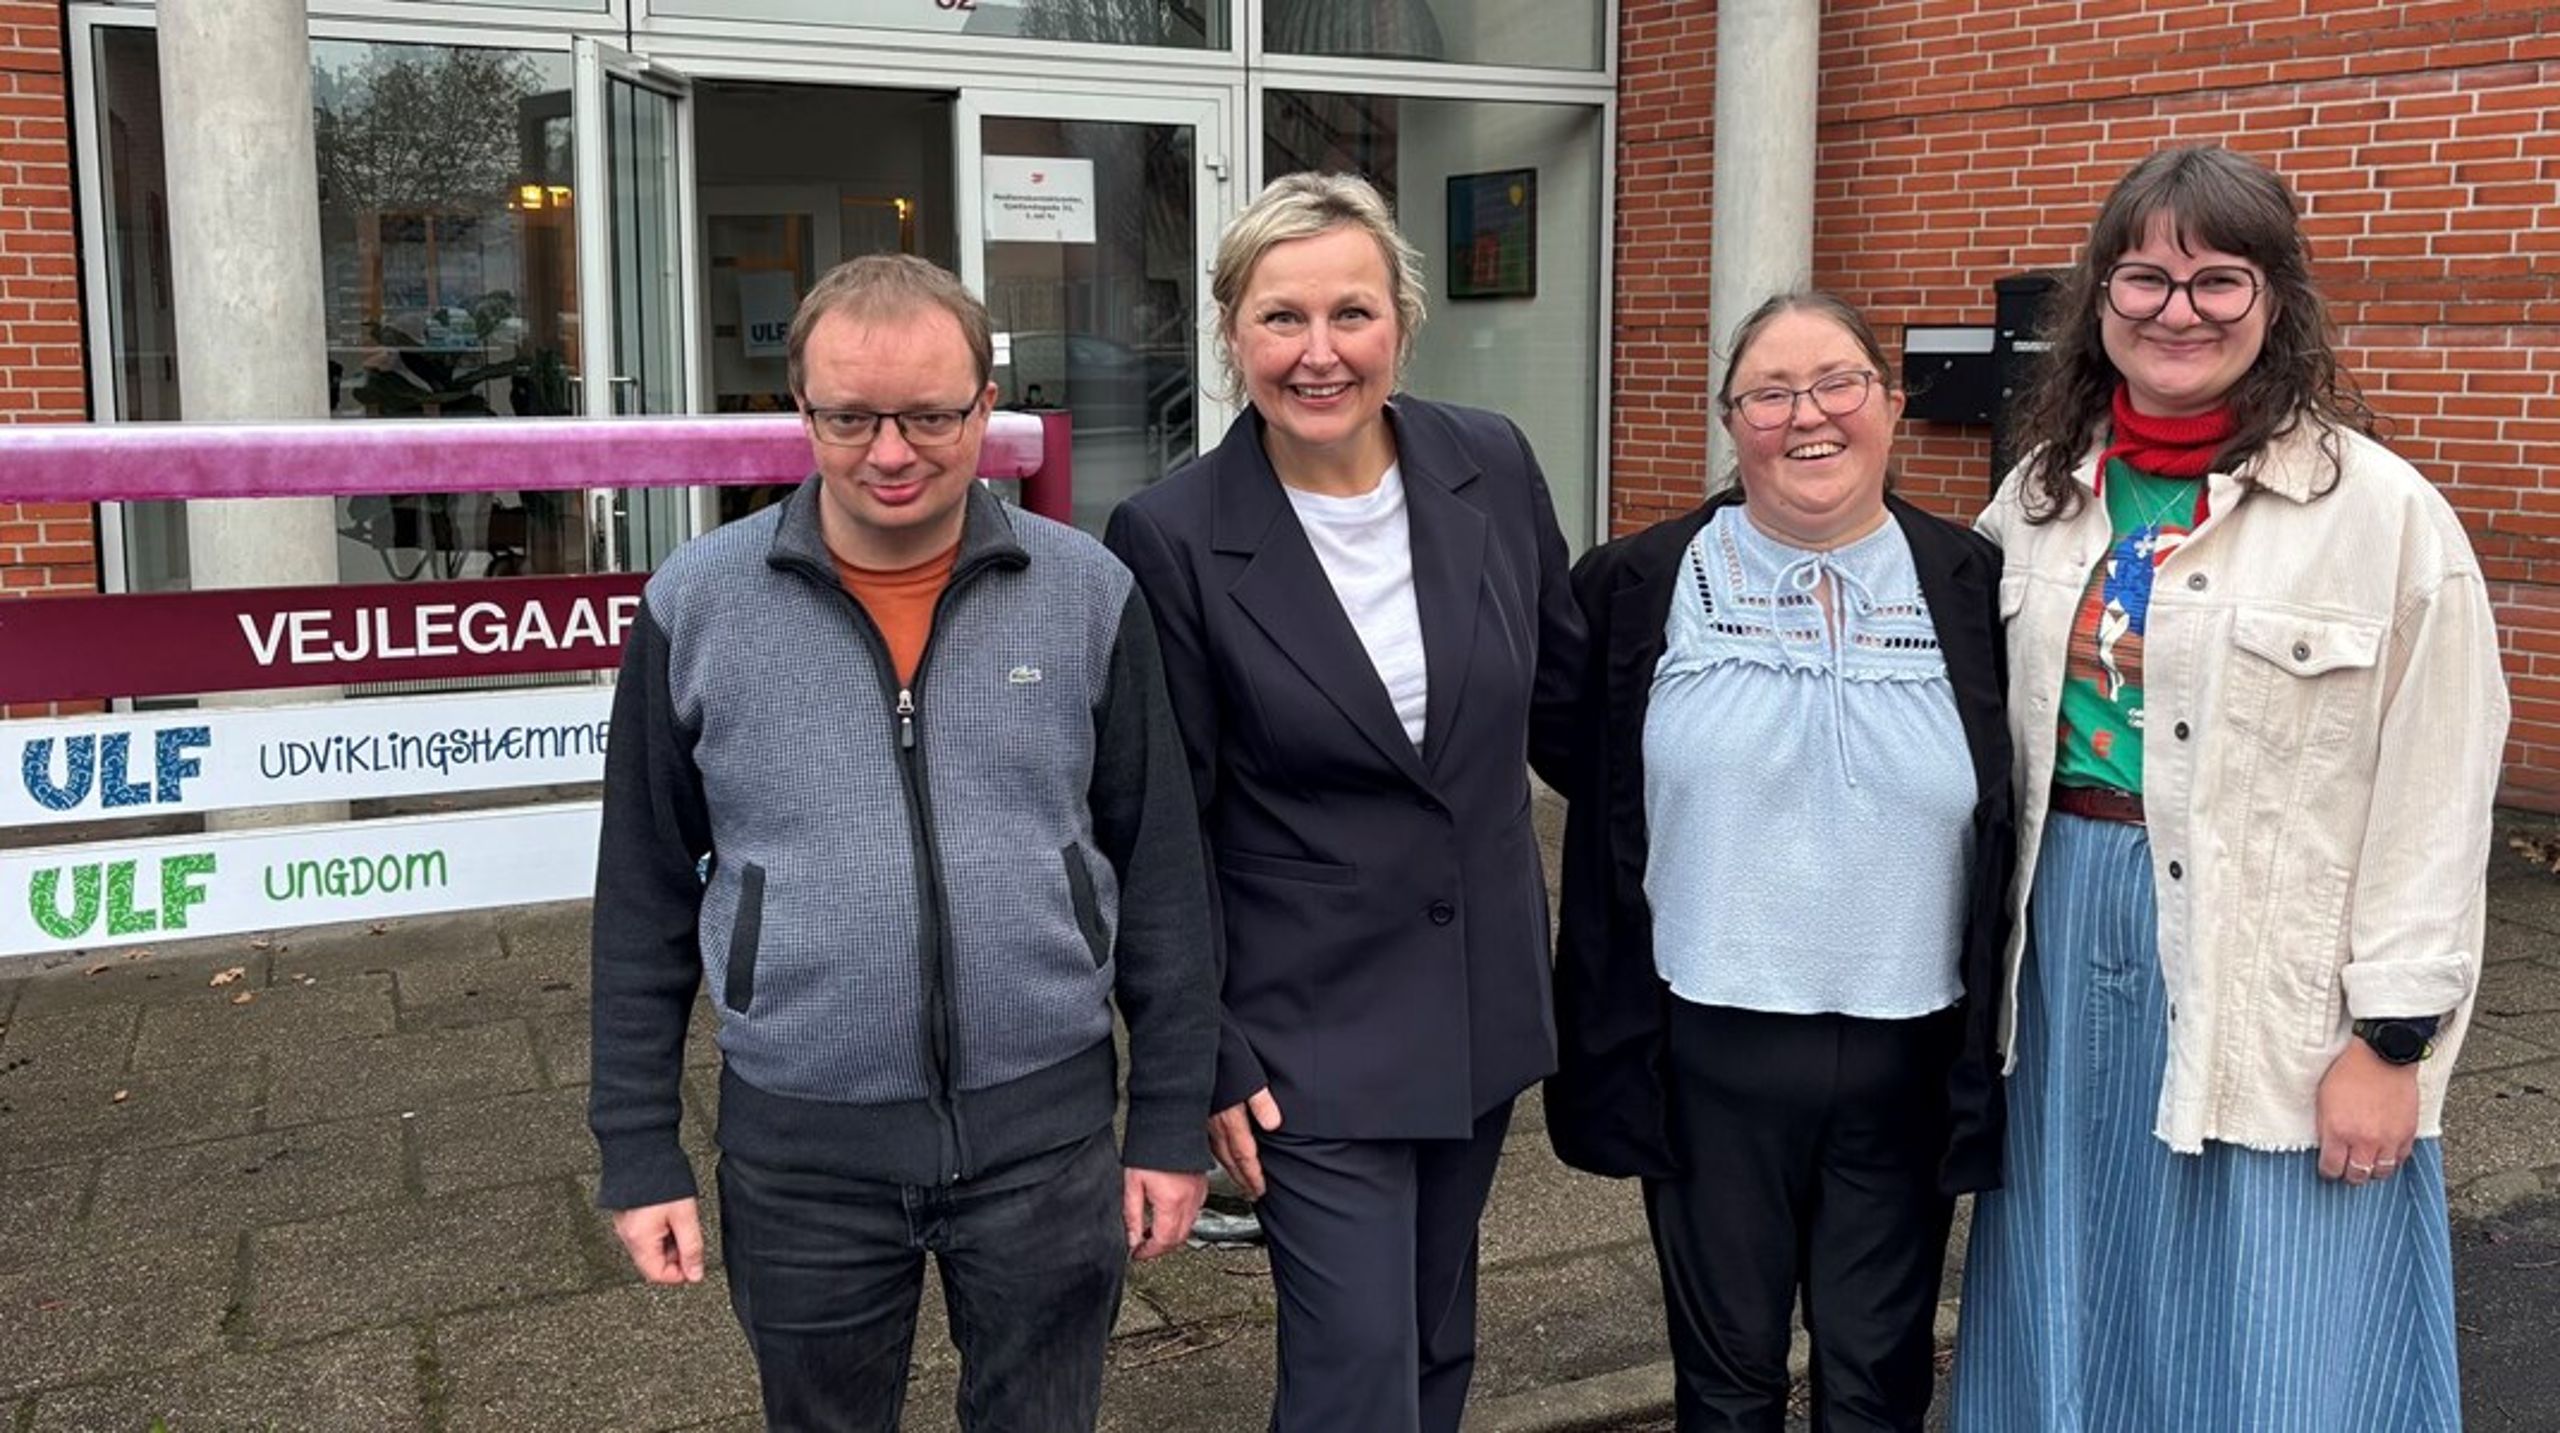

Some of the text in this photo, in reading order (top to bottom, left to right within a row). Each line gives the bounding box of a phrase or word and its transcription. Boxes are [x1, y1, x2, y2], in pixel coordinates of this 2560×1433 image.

[752, 322, 787, 342] ULF
[21, 725, 212, 812] ULF
[28, 853, 217, 940] ULF
